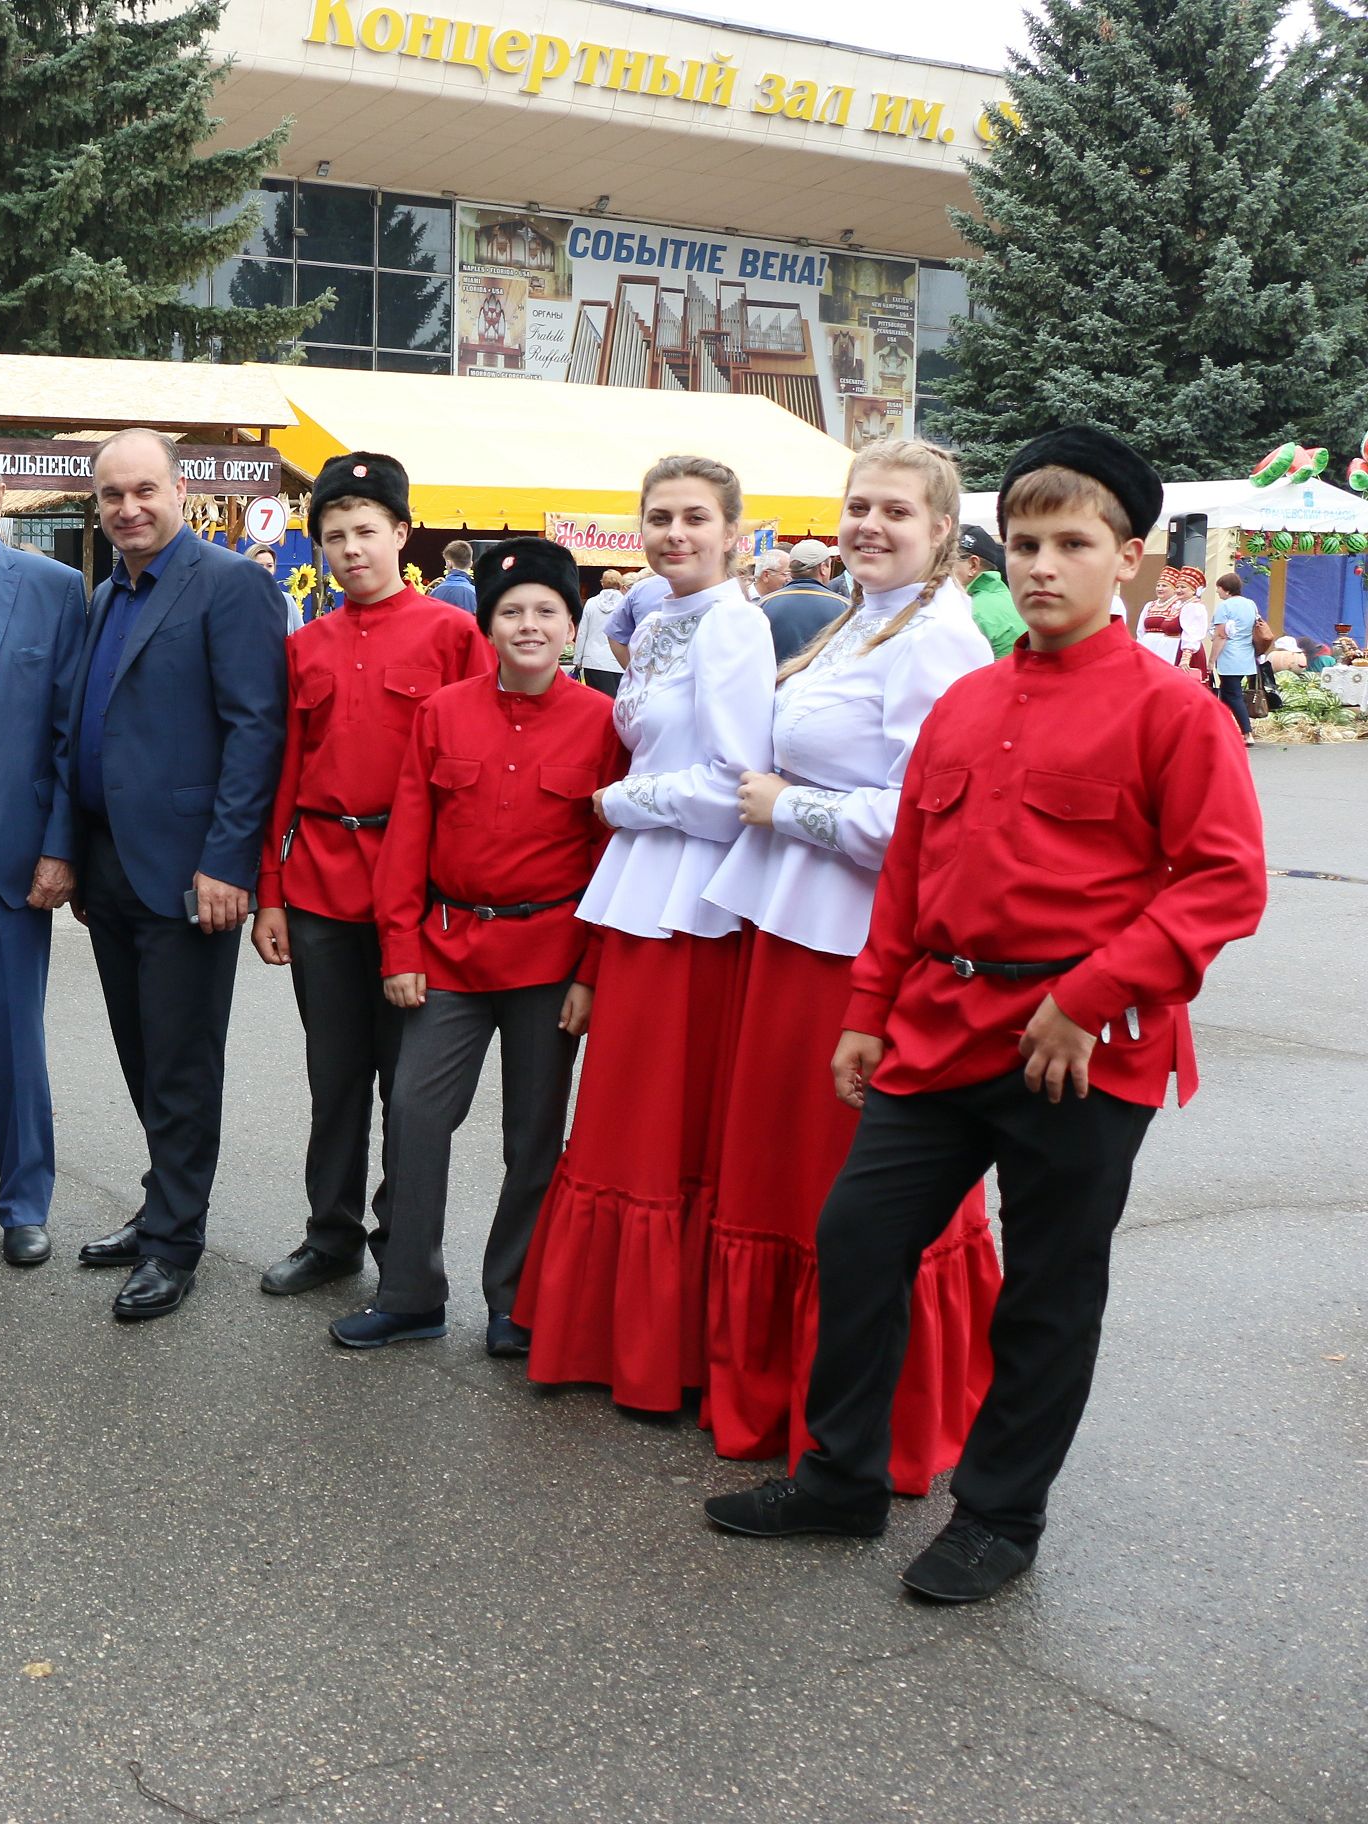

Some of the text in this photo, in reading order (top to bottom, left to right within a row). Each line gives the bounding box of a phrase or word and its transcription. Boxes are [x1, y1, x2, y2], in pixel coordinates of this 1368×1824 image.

[303, 0, 740, 107] Концертный
[752, 72, 856, 127] зал
[866, 92, 955, 143] им.
[568, 227, 827, 287] СОБЫТИЕ ВЕКА!
[462, 264, 531, 278] NAPLES FLORIDA USA
[462, 285, 504, 295] FLORIDA USA
[532, 309, 564, 320] ОРГАНЫ
[526, 322, 567, 343] Fratelli
[223, 460, 273, 481] ОКРУГ
[260, 509, 274, 531] 7
